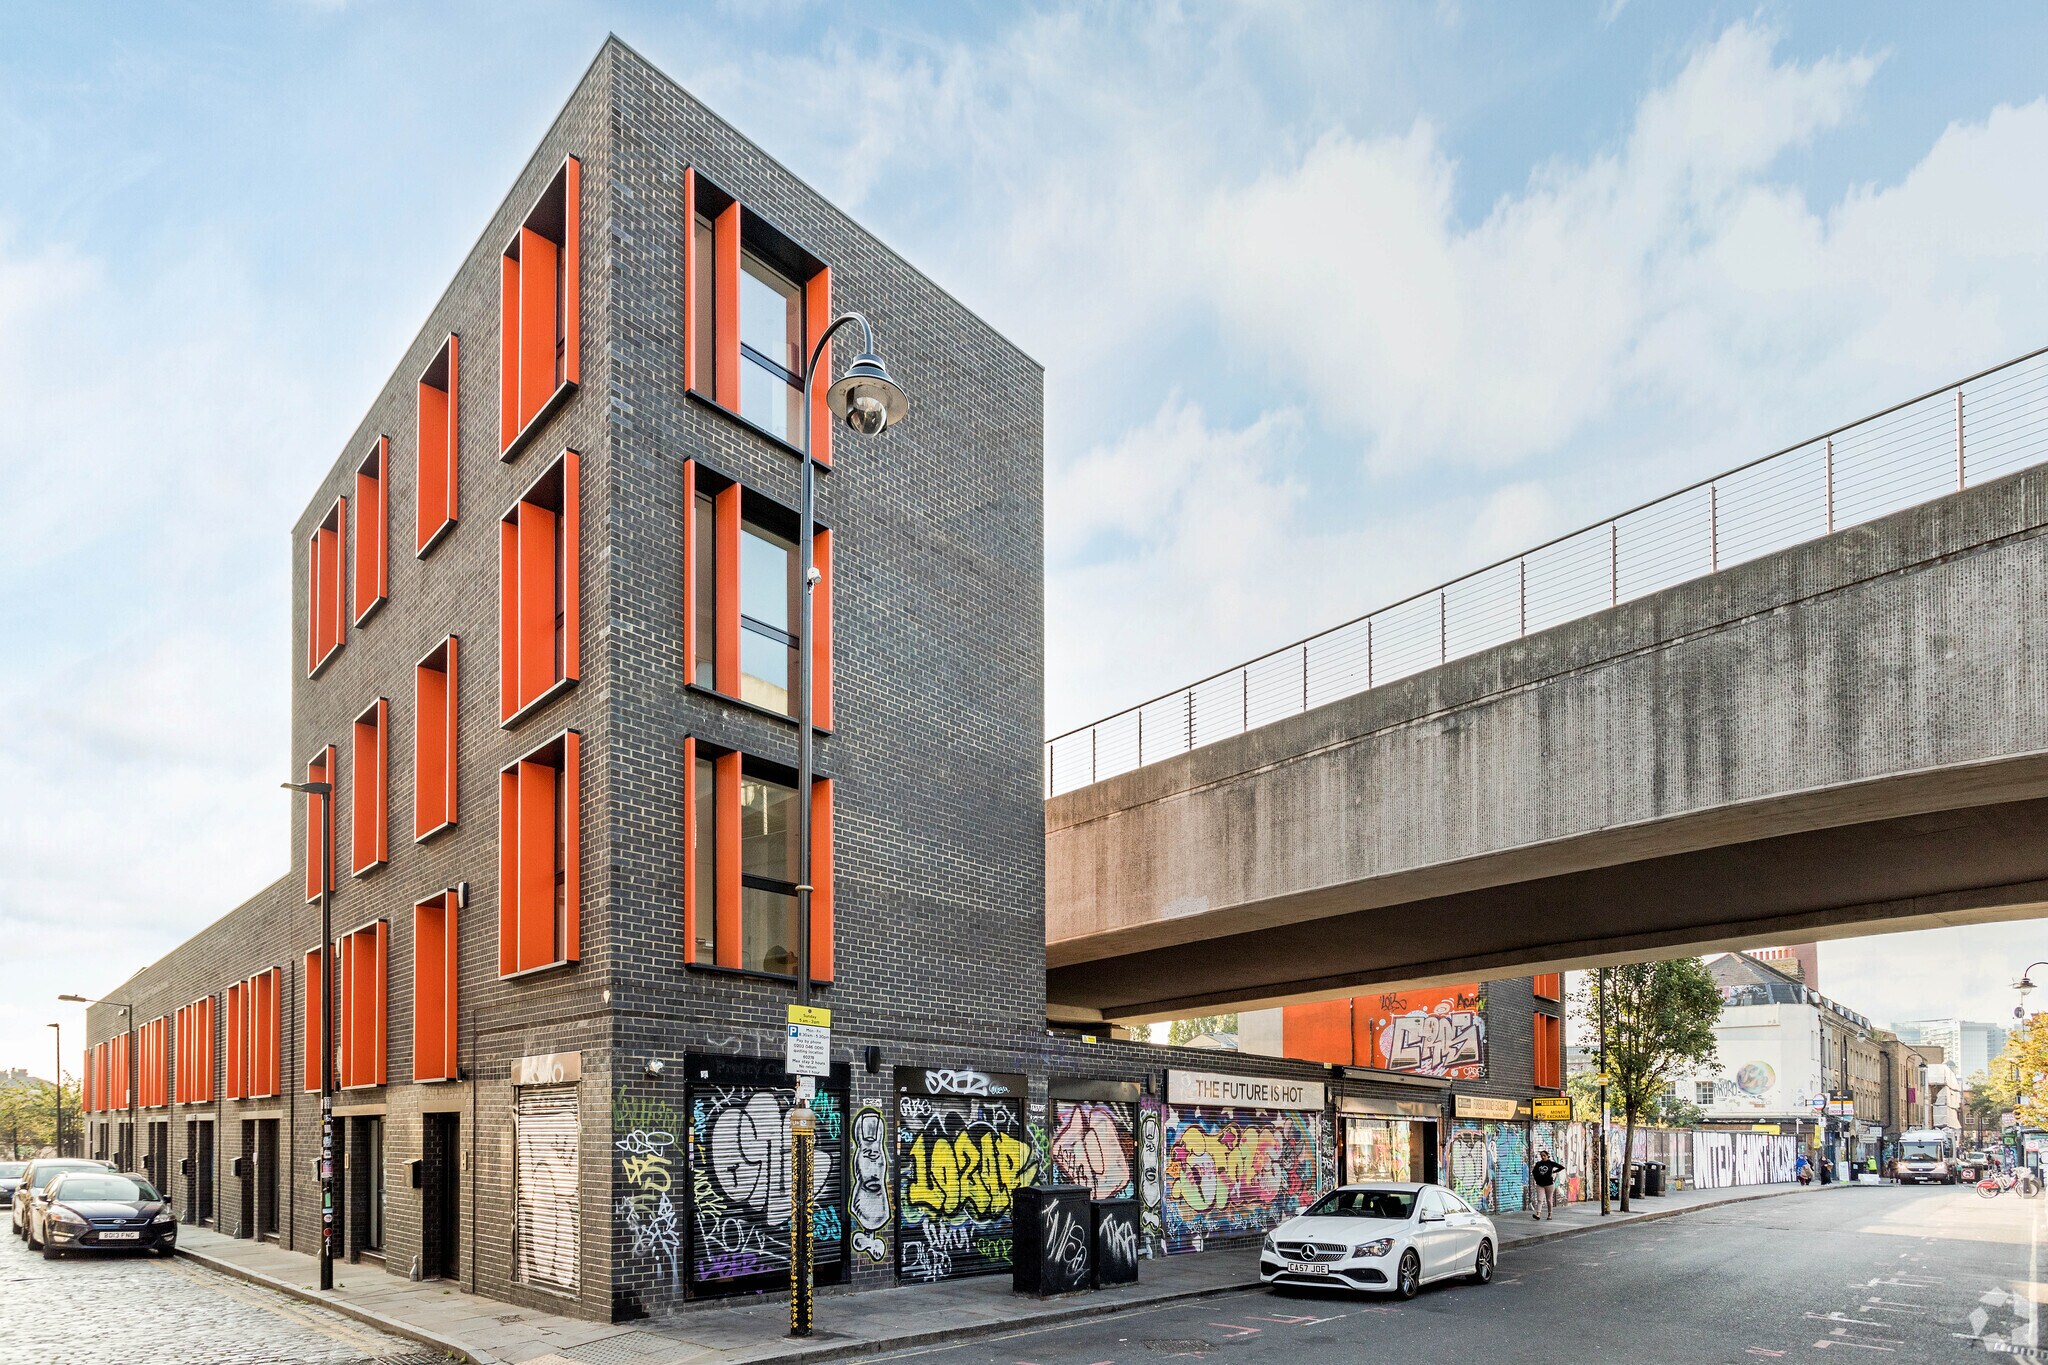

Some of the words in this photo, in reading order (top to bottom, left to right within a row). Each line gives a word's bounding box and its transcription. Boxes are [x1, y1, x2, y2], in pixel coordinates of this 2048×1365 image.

[790, 1026, 797, 1036] P
[1196, 1079, 1220, 1098] THE
[1222, 1082, 1268, 1101] FUTURE
[1270, 1085, 1280, 1101] IS
[1282, 1086, 1303, 1103] HOT
[1290, 1264, 1308, 1272] CA57
[1311, 1265, 1326, 1273] JOE
